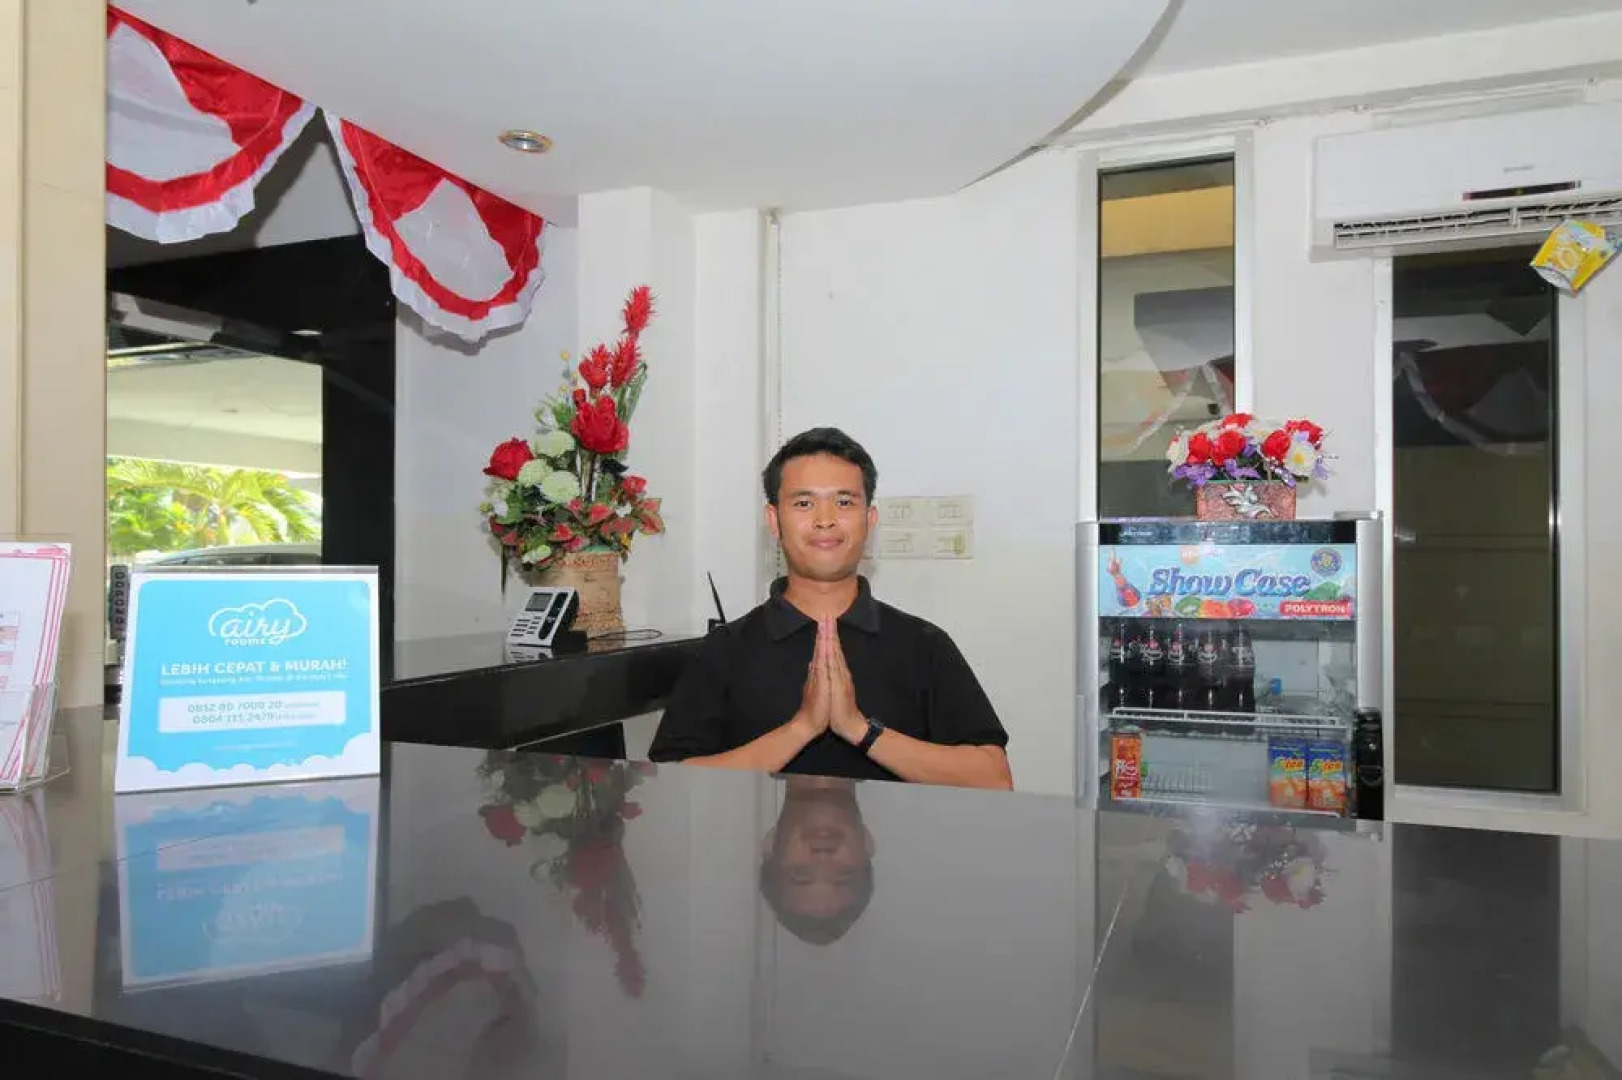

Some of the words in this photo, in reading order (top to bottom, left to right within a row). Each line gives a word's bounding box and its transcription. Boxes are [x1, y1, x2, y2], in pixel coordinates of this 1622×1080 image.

[1149, 566, 1231, 596] Show
[1235, 568, 1311, 597] Case
[1284, 603, 1346, 614] POLYTRON
[220, 610, 292, 646] airy
[161, 662, 209, 676] LEBIH
[213, 661, 266, 674] CEPAT
[270, 661, 280, 672] &
[285, 658, 347, 671] MURAH!
